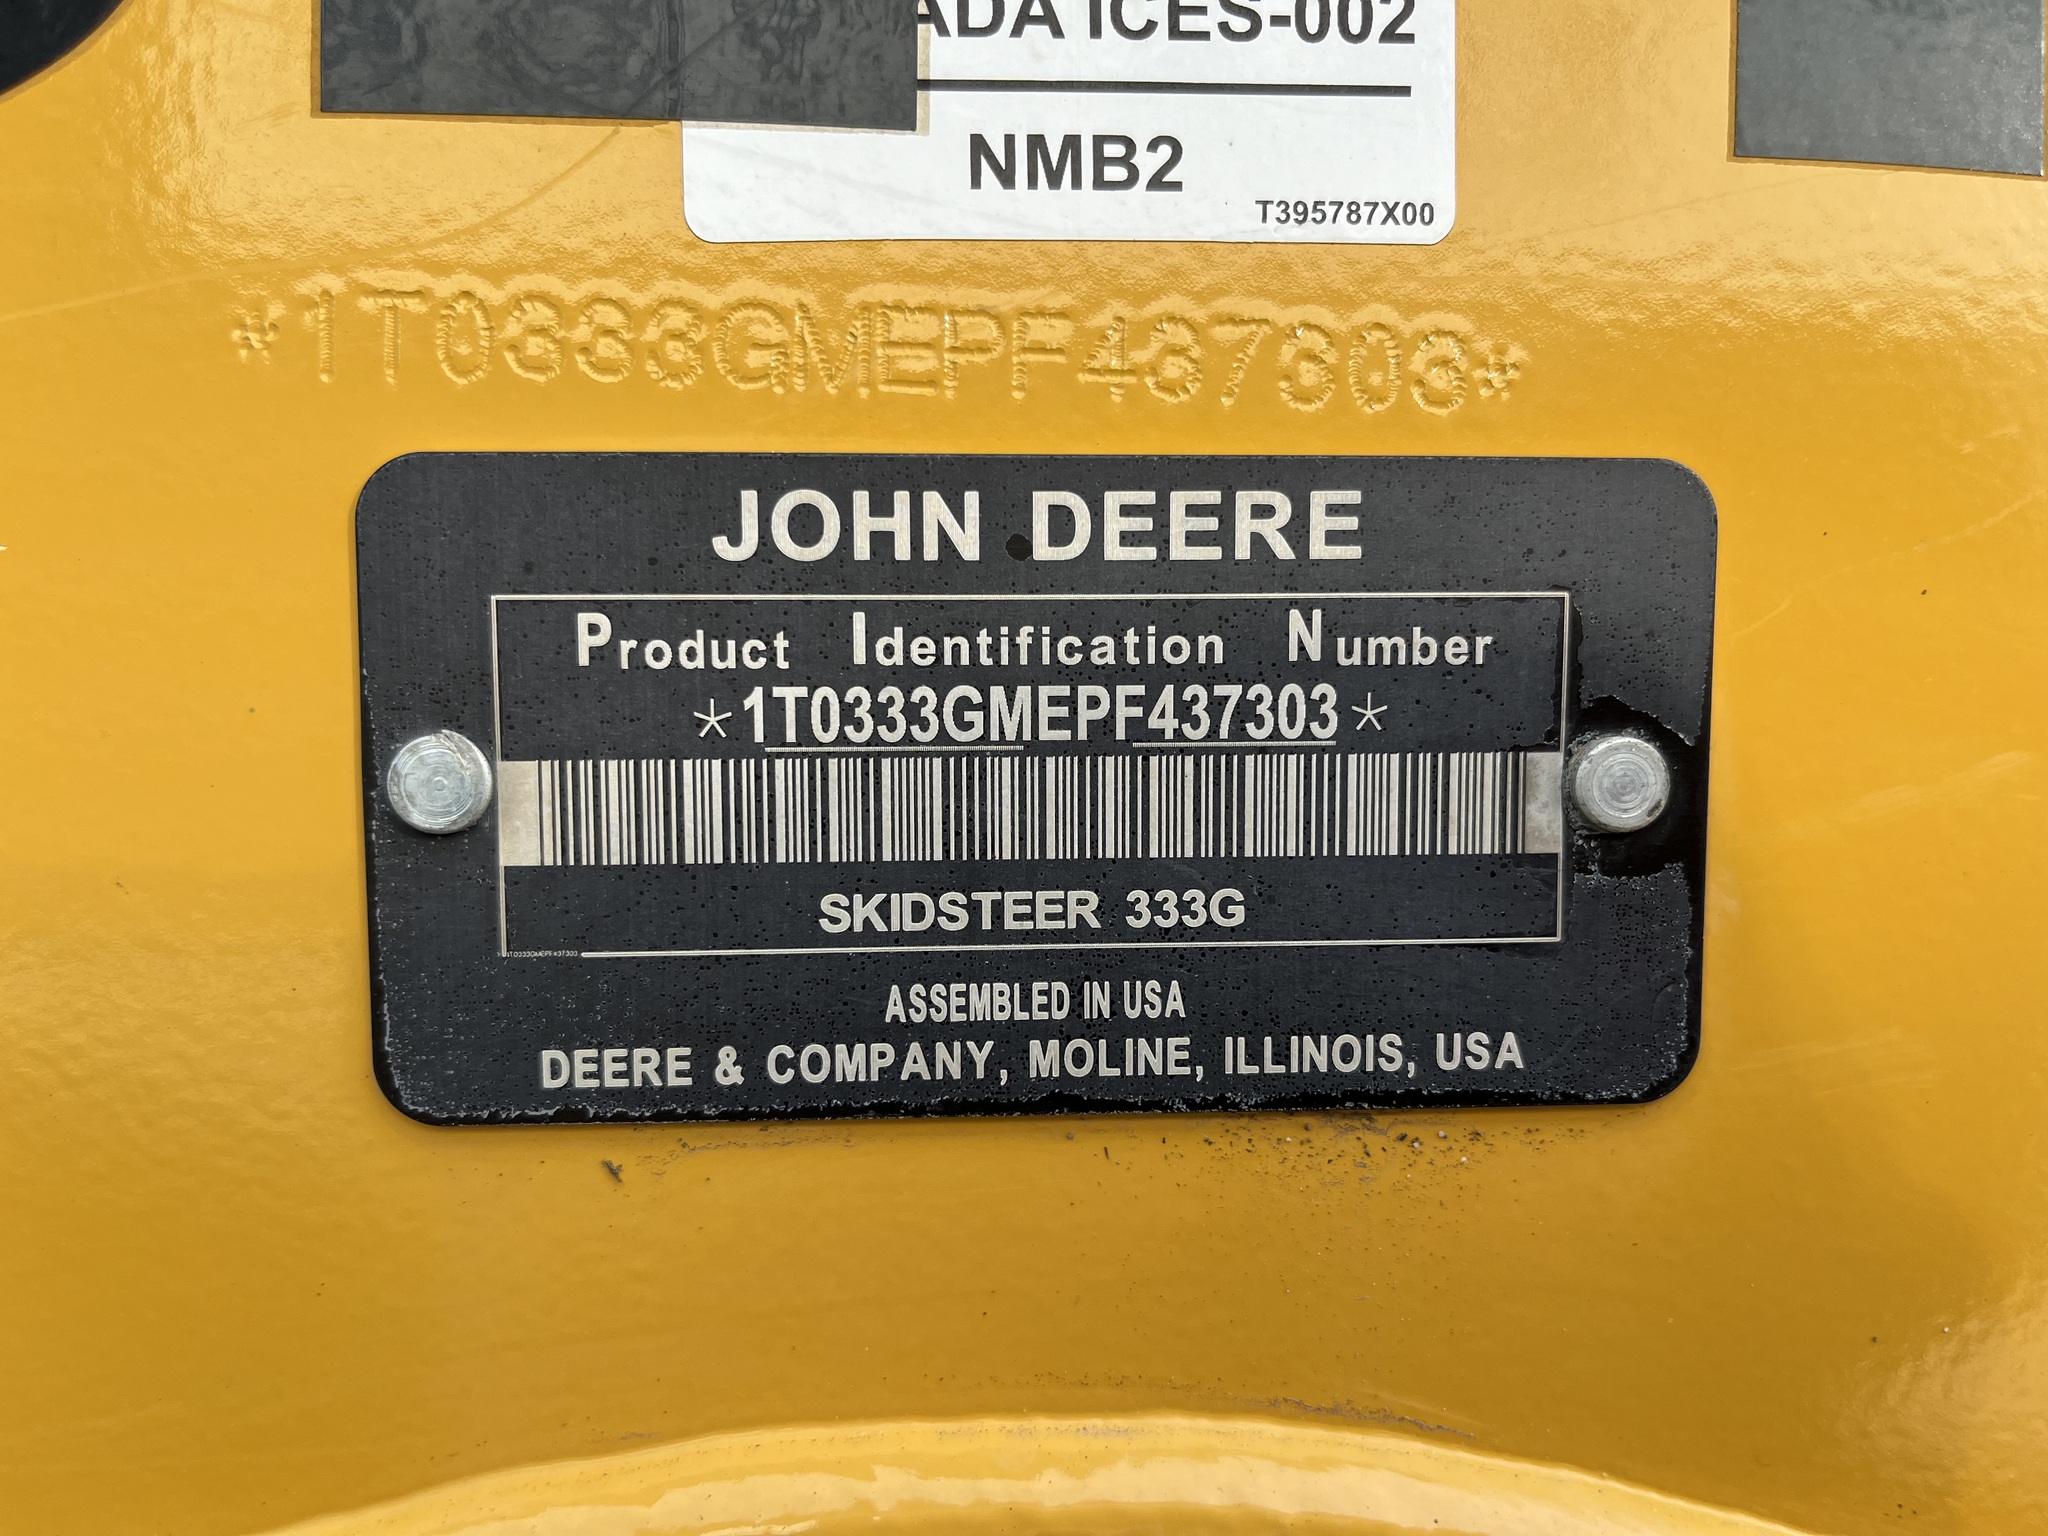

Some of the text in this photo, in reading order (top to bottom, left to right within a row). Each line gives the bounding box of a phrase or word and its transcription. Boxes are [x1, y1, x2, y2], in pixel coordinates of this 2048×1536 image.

[1089, 0, 1416, 44] ICES-002
[970, 134, 1184, 192] NMB2
[1255, 200, 1435, 226] T395787X00
[711, 489, 1363, 561] JOHN DEERE
[577, 608, 1494, 670] Product Identification Number
[818, 888, 1247, 934] SKIDSTEER 333G
[885, 980, 1187, 1023] ASSEMBLED IN USA
[541, 1031, 1525, 1089] DEERE & COMPANY, MOLINE, ILLINOIS, USA
